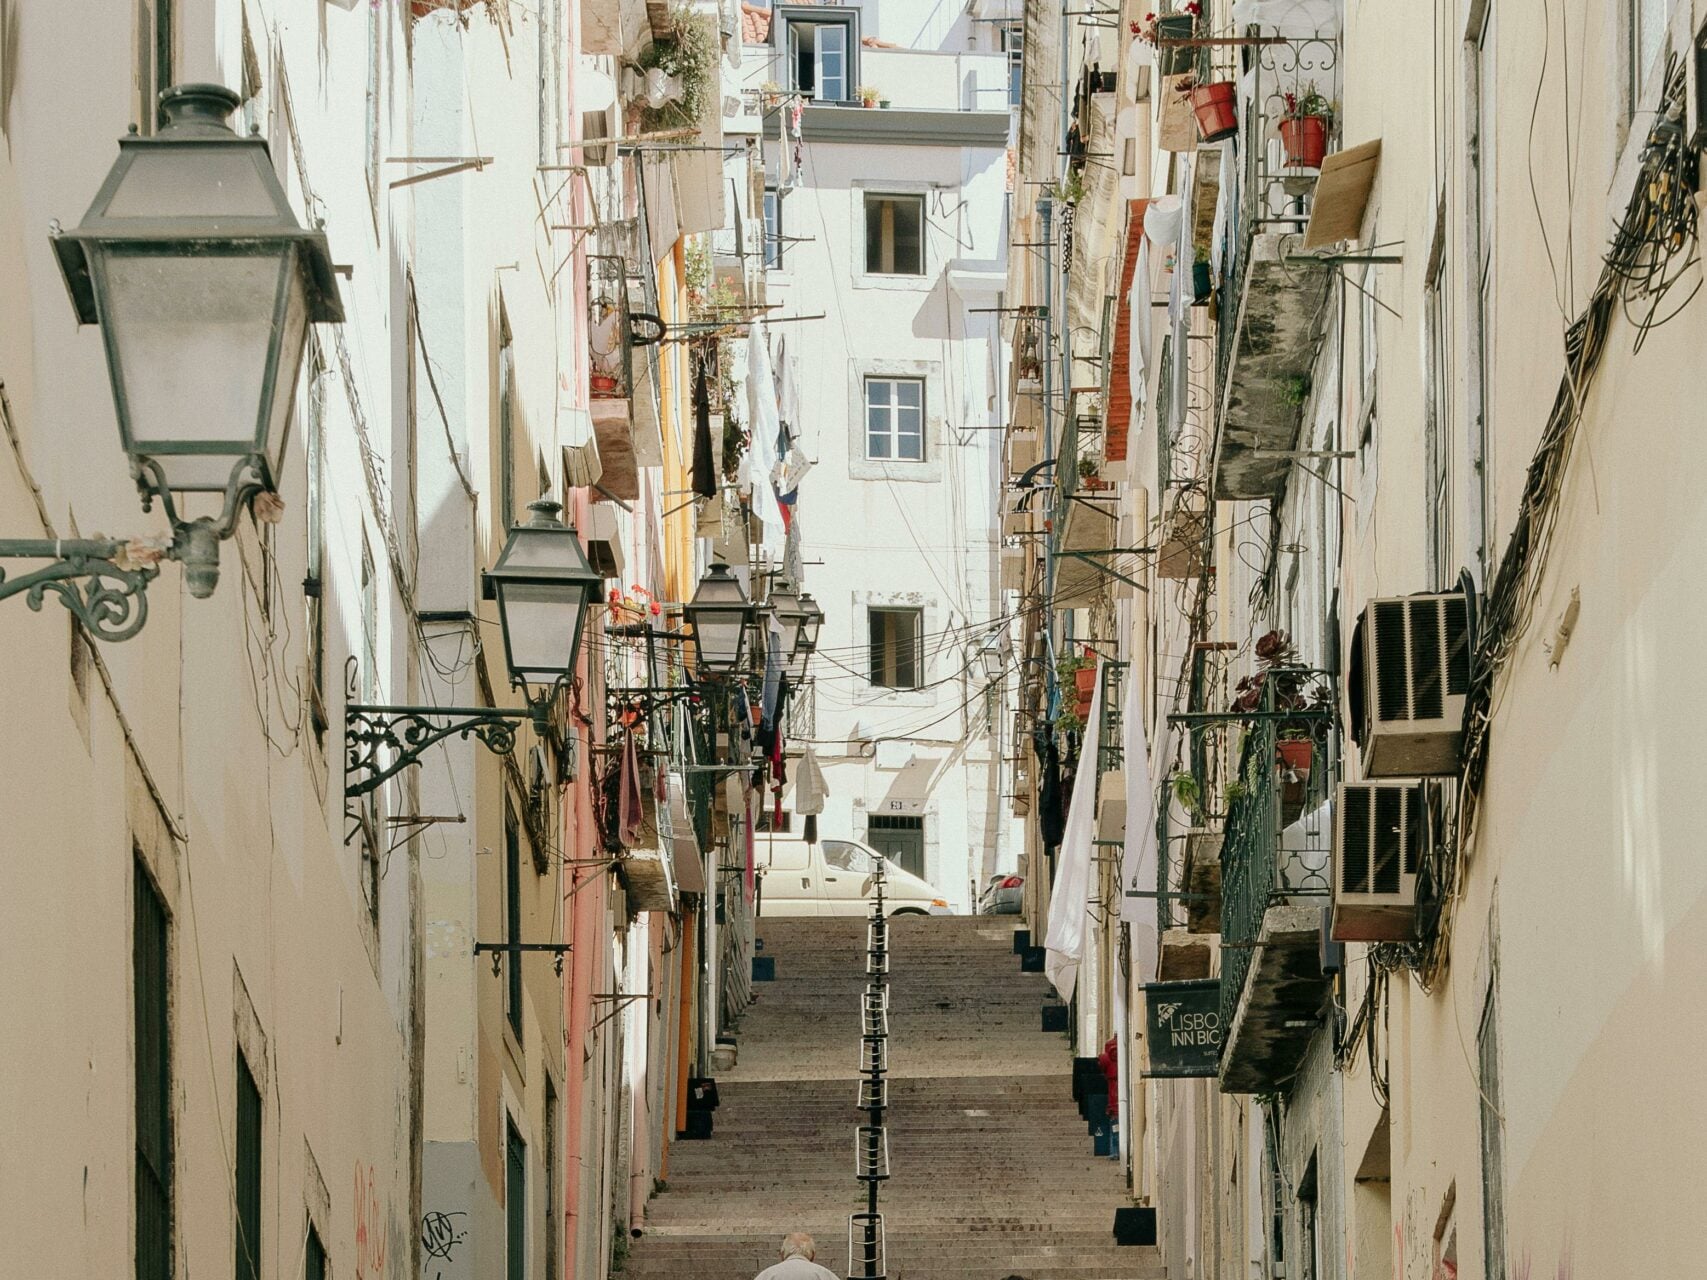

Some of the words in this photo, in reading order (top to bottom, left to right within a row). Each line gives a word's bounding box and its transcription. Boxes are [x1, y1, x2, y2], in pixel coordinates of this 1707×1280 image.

[1170, 1012, 1219, 1031] LISBO
[1171, 1031, 1194, 1047] INN
[1197, 1030, 1220, 1045] BIC
